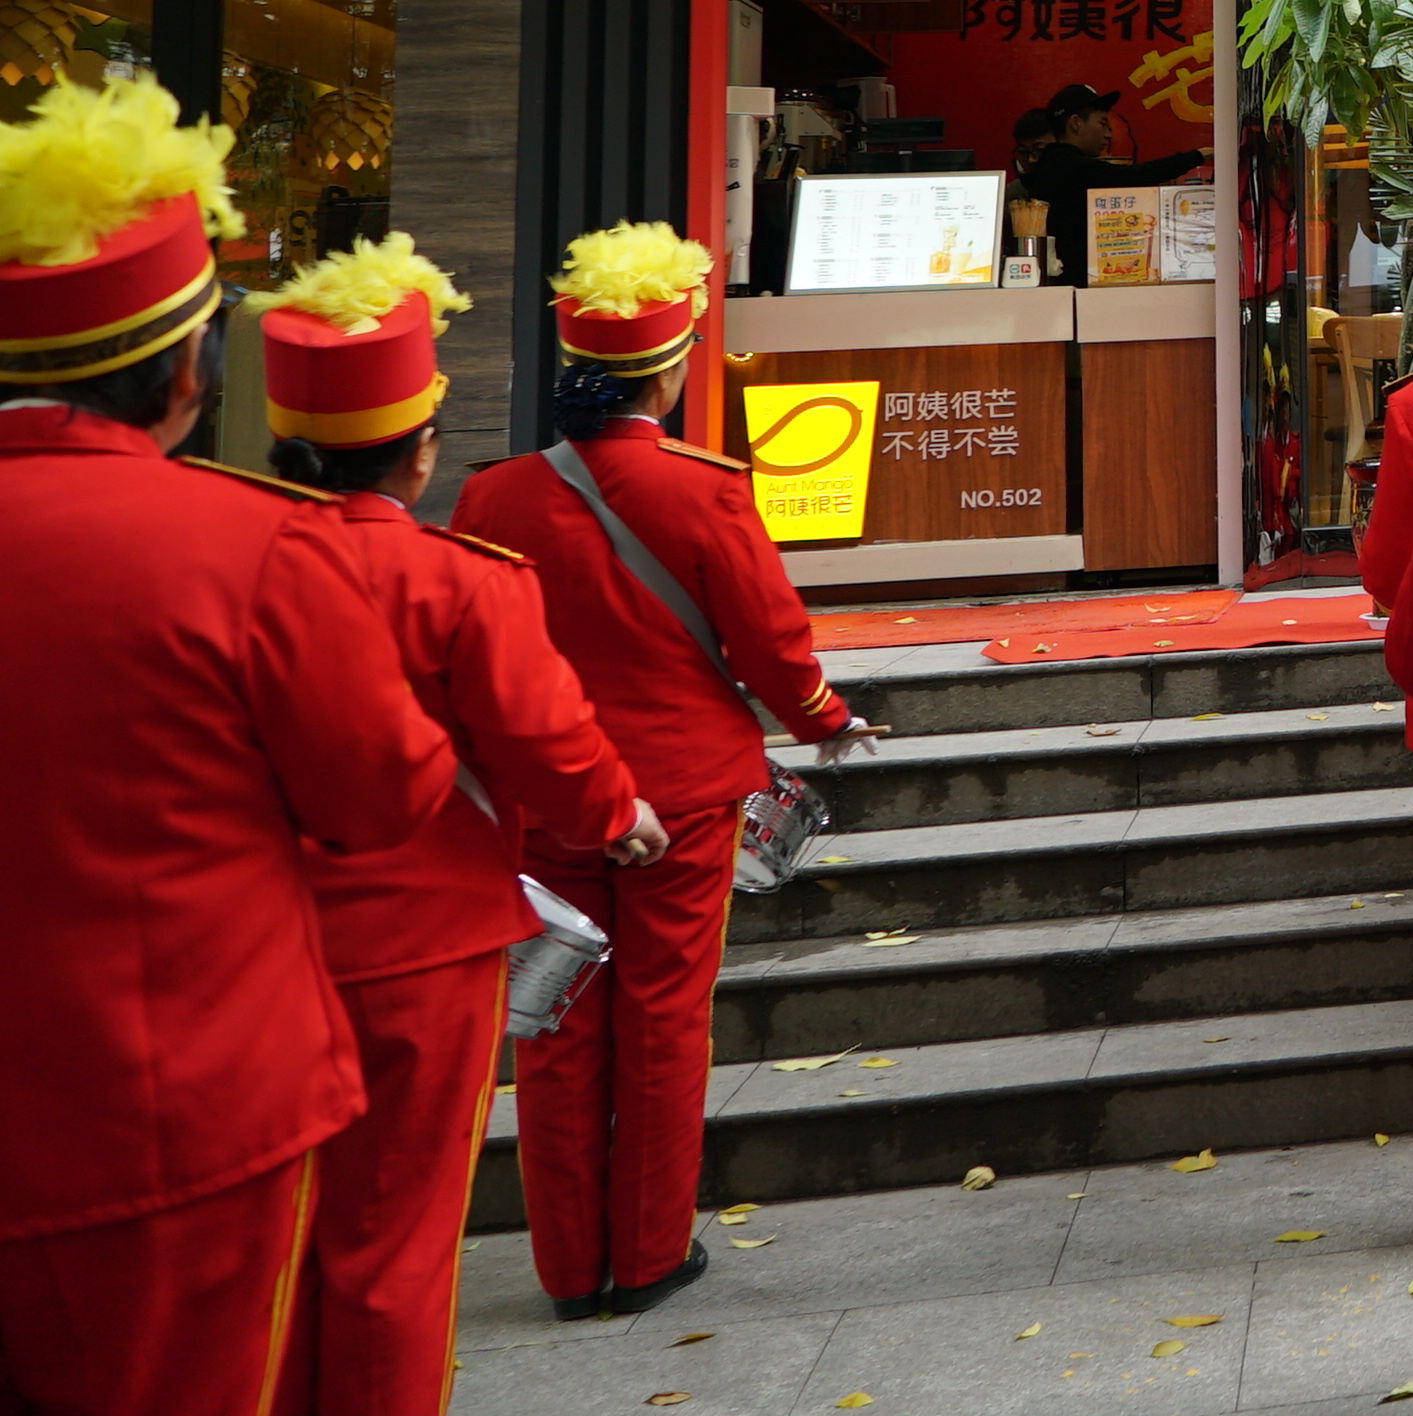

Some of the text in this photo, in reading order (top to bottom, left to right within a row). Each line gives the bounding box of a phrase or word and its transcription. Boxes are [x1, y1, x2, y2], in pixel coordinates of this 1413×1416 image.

[884, 388, 1017, 422] 阿姨很芒
[881, 425, 1020, 460] 不得不尝
[960, 488, 1042, 509] NO.502
